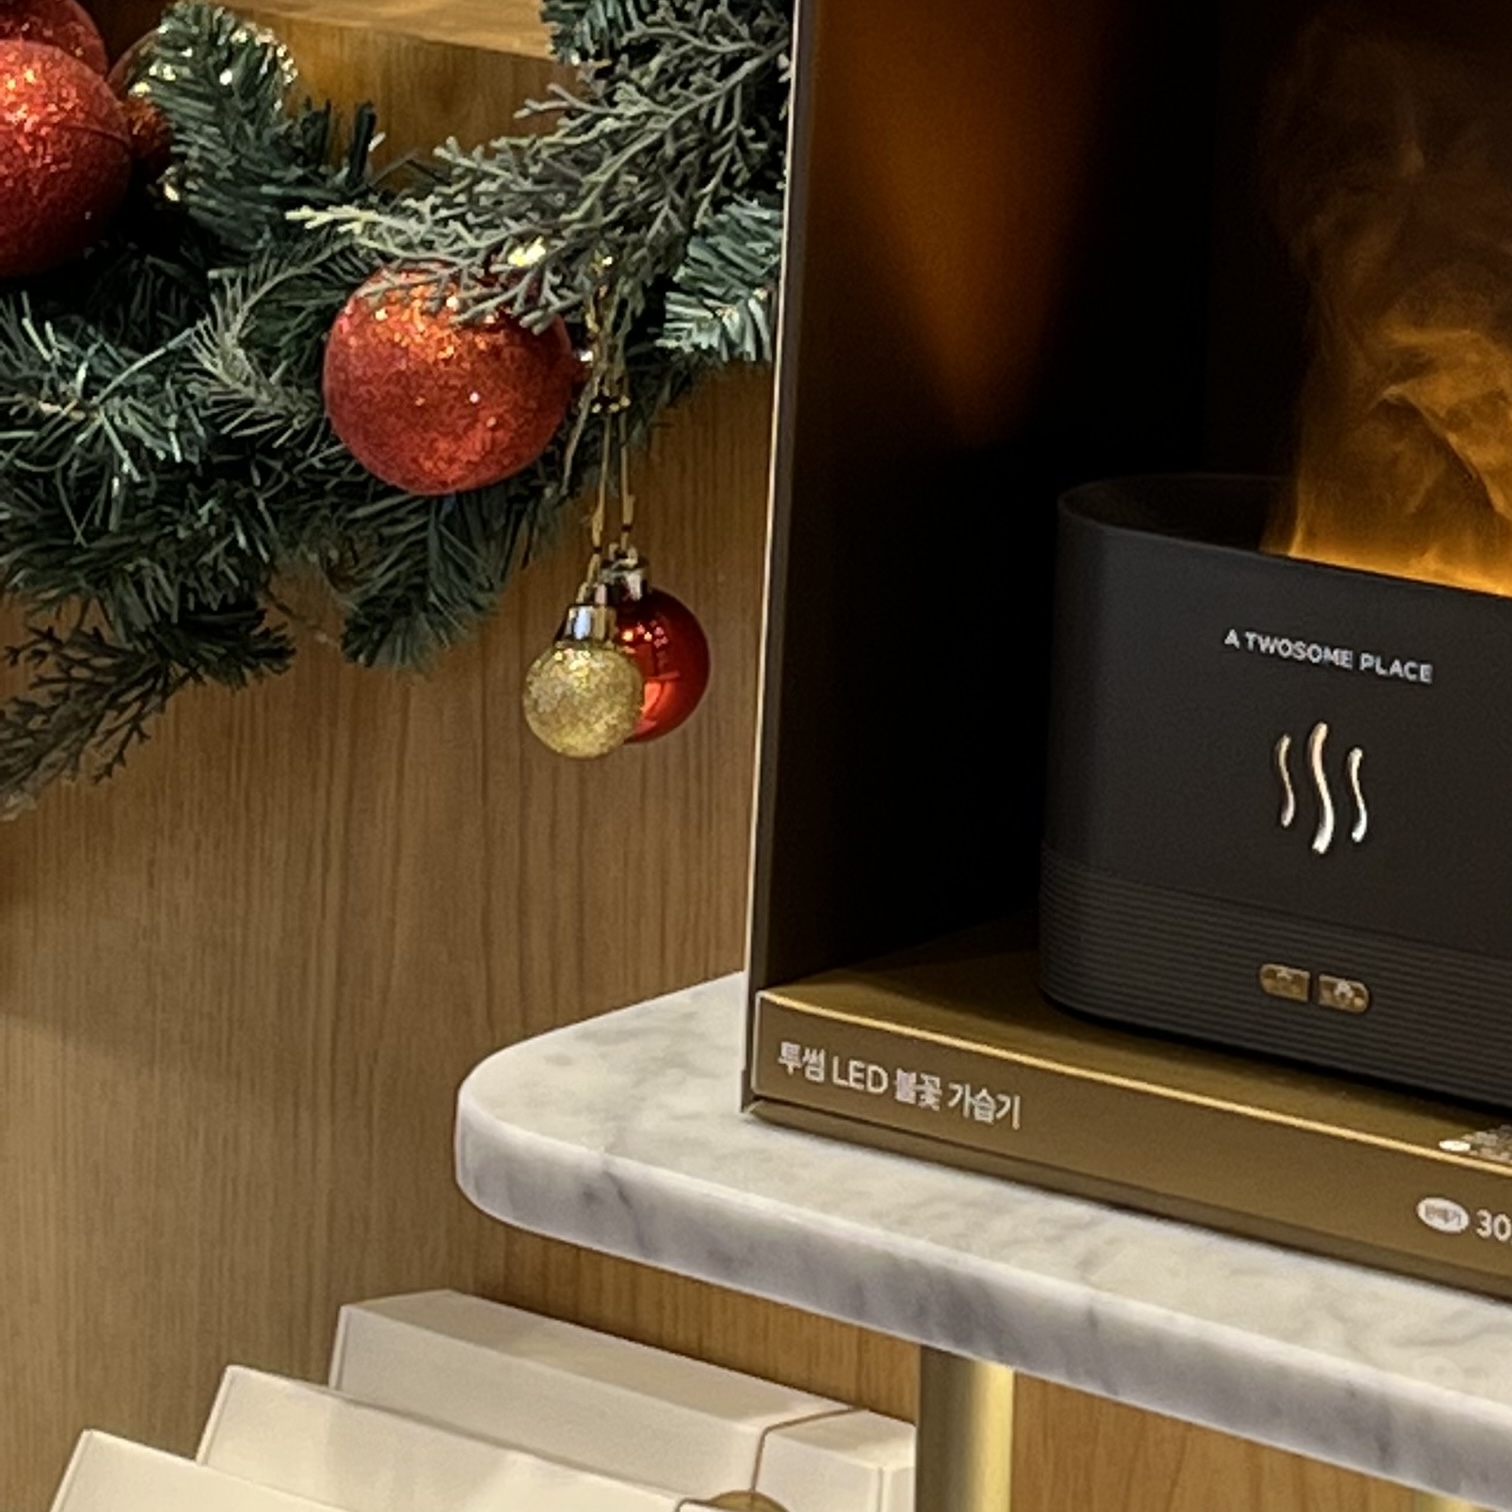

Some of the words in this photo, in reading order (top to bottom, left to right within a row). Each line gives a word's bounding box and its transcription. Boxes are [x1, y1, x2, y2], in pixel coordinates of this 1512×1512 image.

[1224, 628, 1241, 650] A
[1244, 630, 1353, 670] TWOSOME
[1359, 652, 1433, 684] PLACE
[778, 1041, 826, 1083] 투썸
[832, 1055, 889, 1094] LED
[893, 1068, 942, 1112] 불꽃
[948, 1082, 1021, 1131] 가습기
